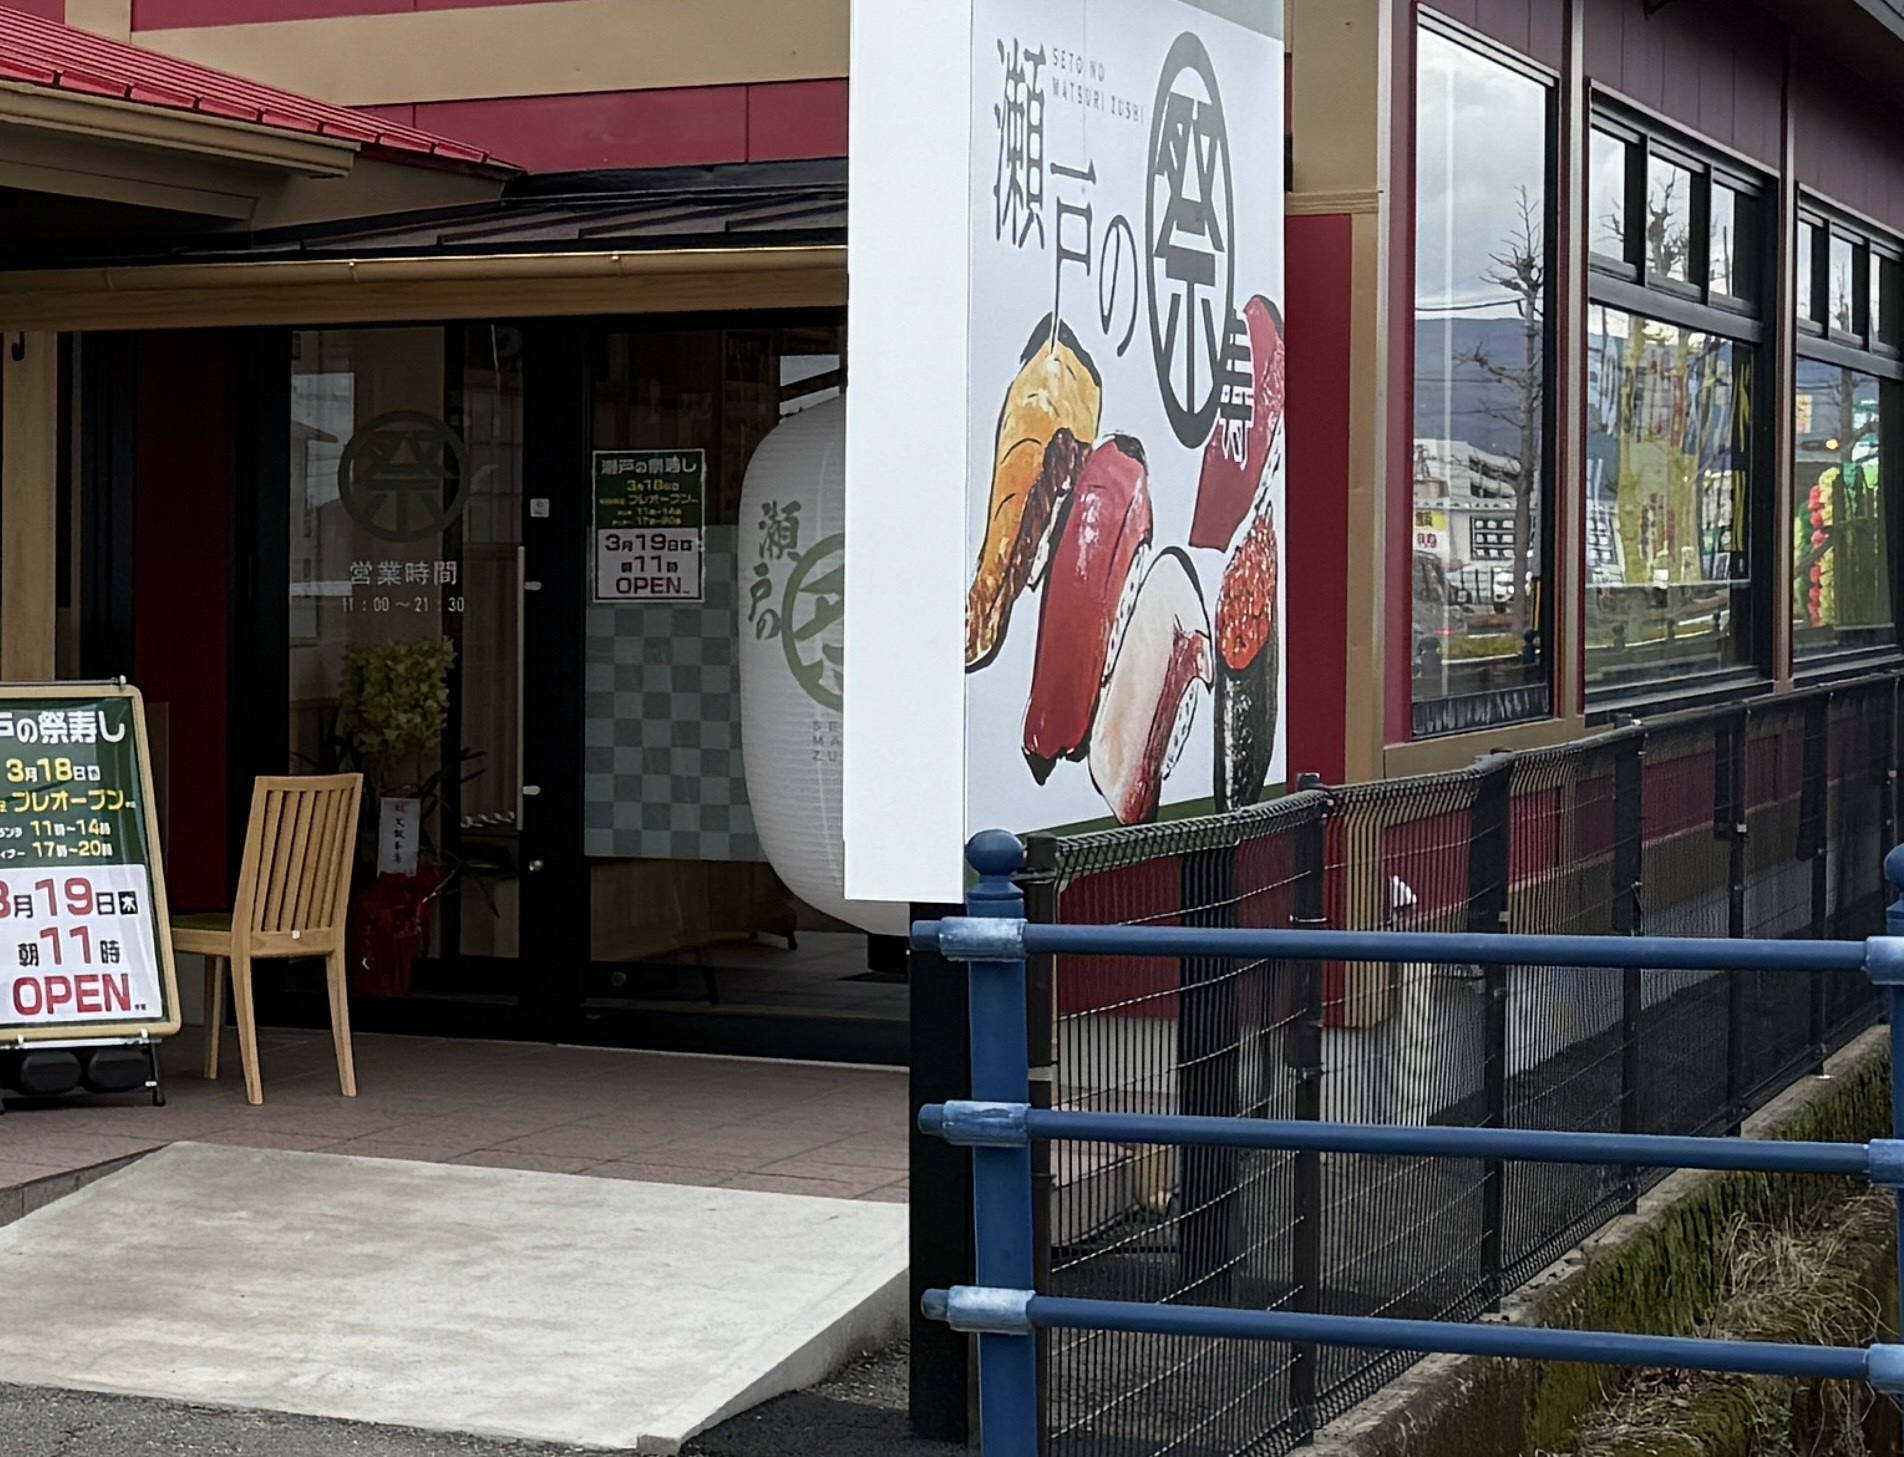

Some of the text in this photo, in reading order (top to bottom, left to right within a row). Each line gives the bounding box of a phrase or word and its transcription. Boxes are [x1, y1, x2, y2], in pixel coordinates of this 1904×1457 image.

[1053, 48, 1105, 82] SETO NO
[1052, 76, 1145, 124] MATSURI ZUSHI
[993, 37, 1139, 358] 瀬戸の
[350, 560, 458, 586] 営業時間
[616, 577, 681, 594] OPEN
[17, 925, 121, 967] 朝11時
[12, 973, 131, 1016] OPEN
